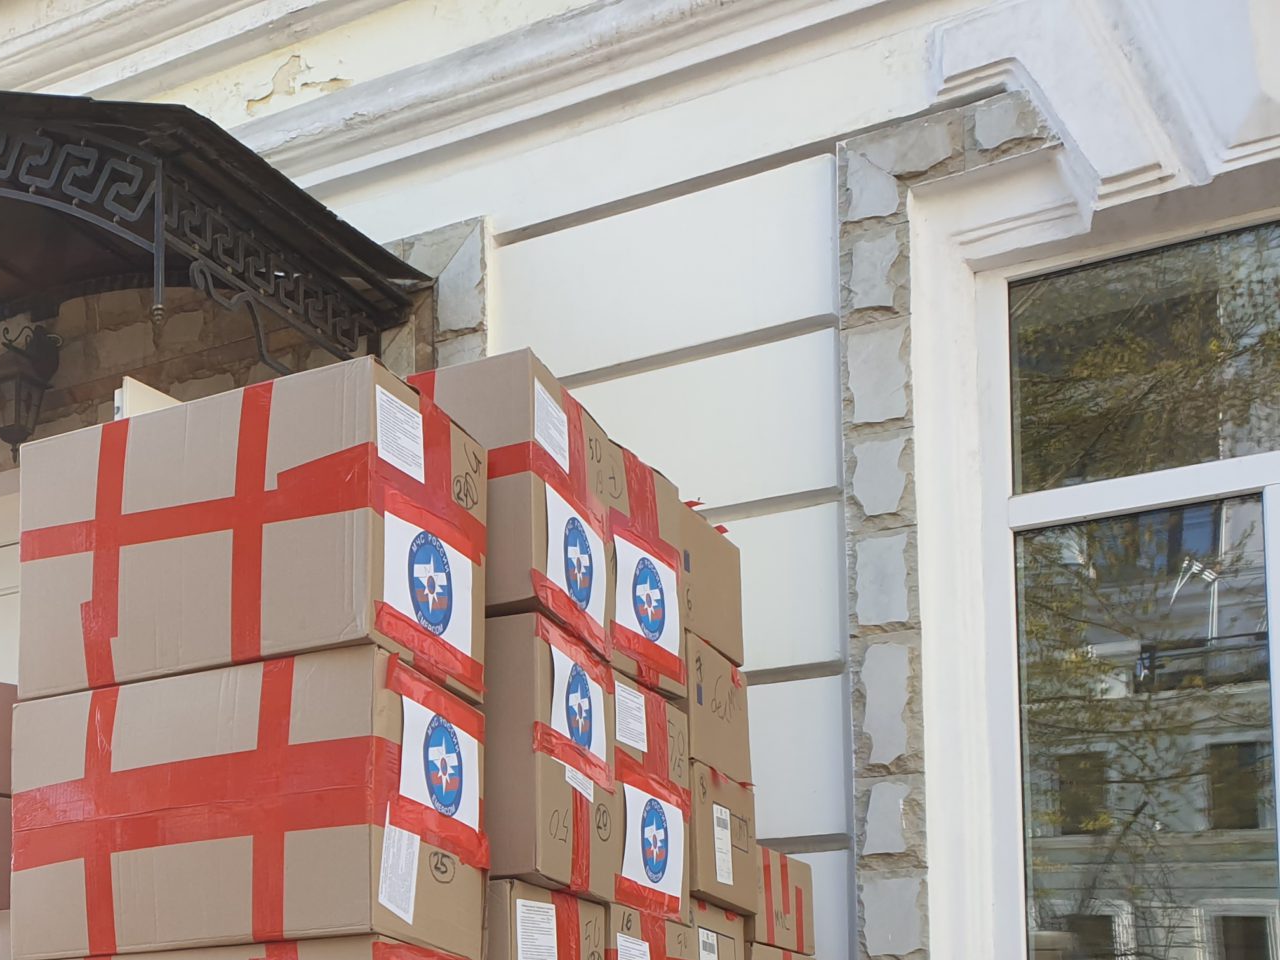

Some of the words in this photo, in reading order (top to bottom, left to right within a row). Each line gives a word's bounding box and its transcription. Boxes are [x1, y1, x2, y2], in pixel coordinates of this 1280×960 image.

[411, 534, 425, 553] МЧС
[428, 534, 450, 573] РОССИИ
[417, 611, 444, 635] EMERCOM
[427, 717, 439, 737] МЧС
[440, 717, 460, 752] РОССИИ
[432, 794, 456, 816] EMERCOM
[431, 851, 451, 879] 25
[621, 911, 633, 932] 16
